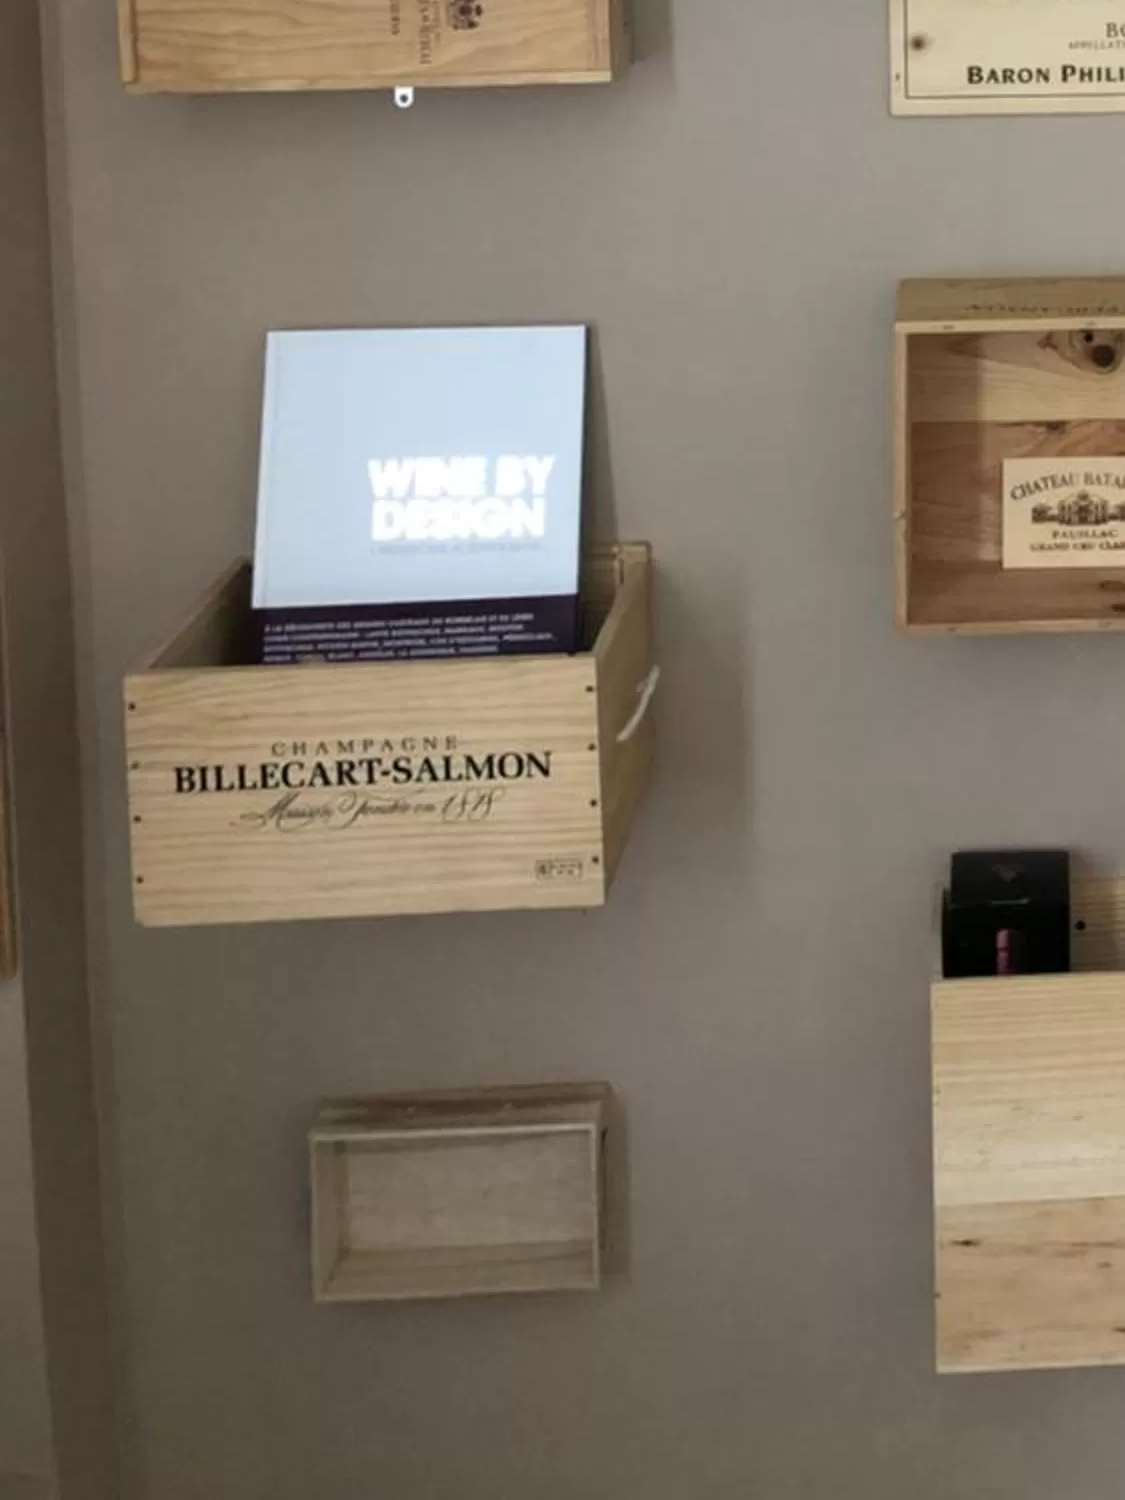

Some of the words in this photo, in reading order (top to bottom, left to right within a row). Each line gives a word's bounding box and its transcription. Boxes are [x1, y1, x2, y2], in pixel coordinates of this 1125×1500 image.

[966, 65, 1052, 86] BARON
[495, 455, 556, 497] BY
[371, 498, 546, 542] DESIGN
[270, 735, 459, 758] CHAMPAGNE
[173, 750, 552, 794] BILLECART-SALMON
